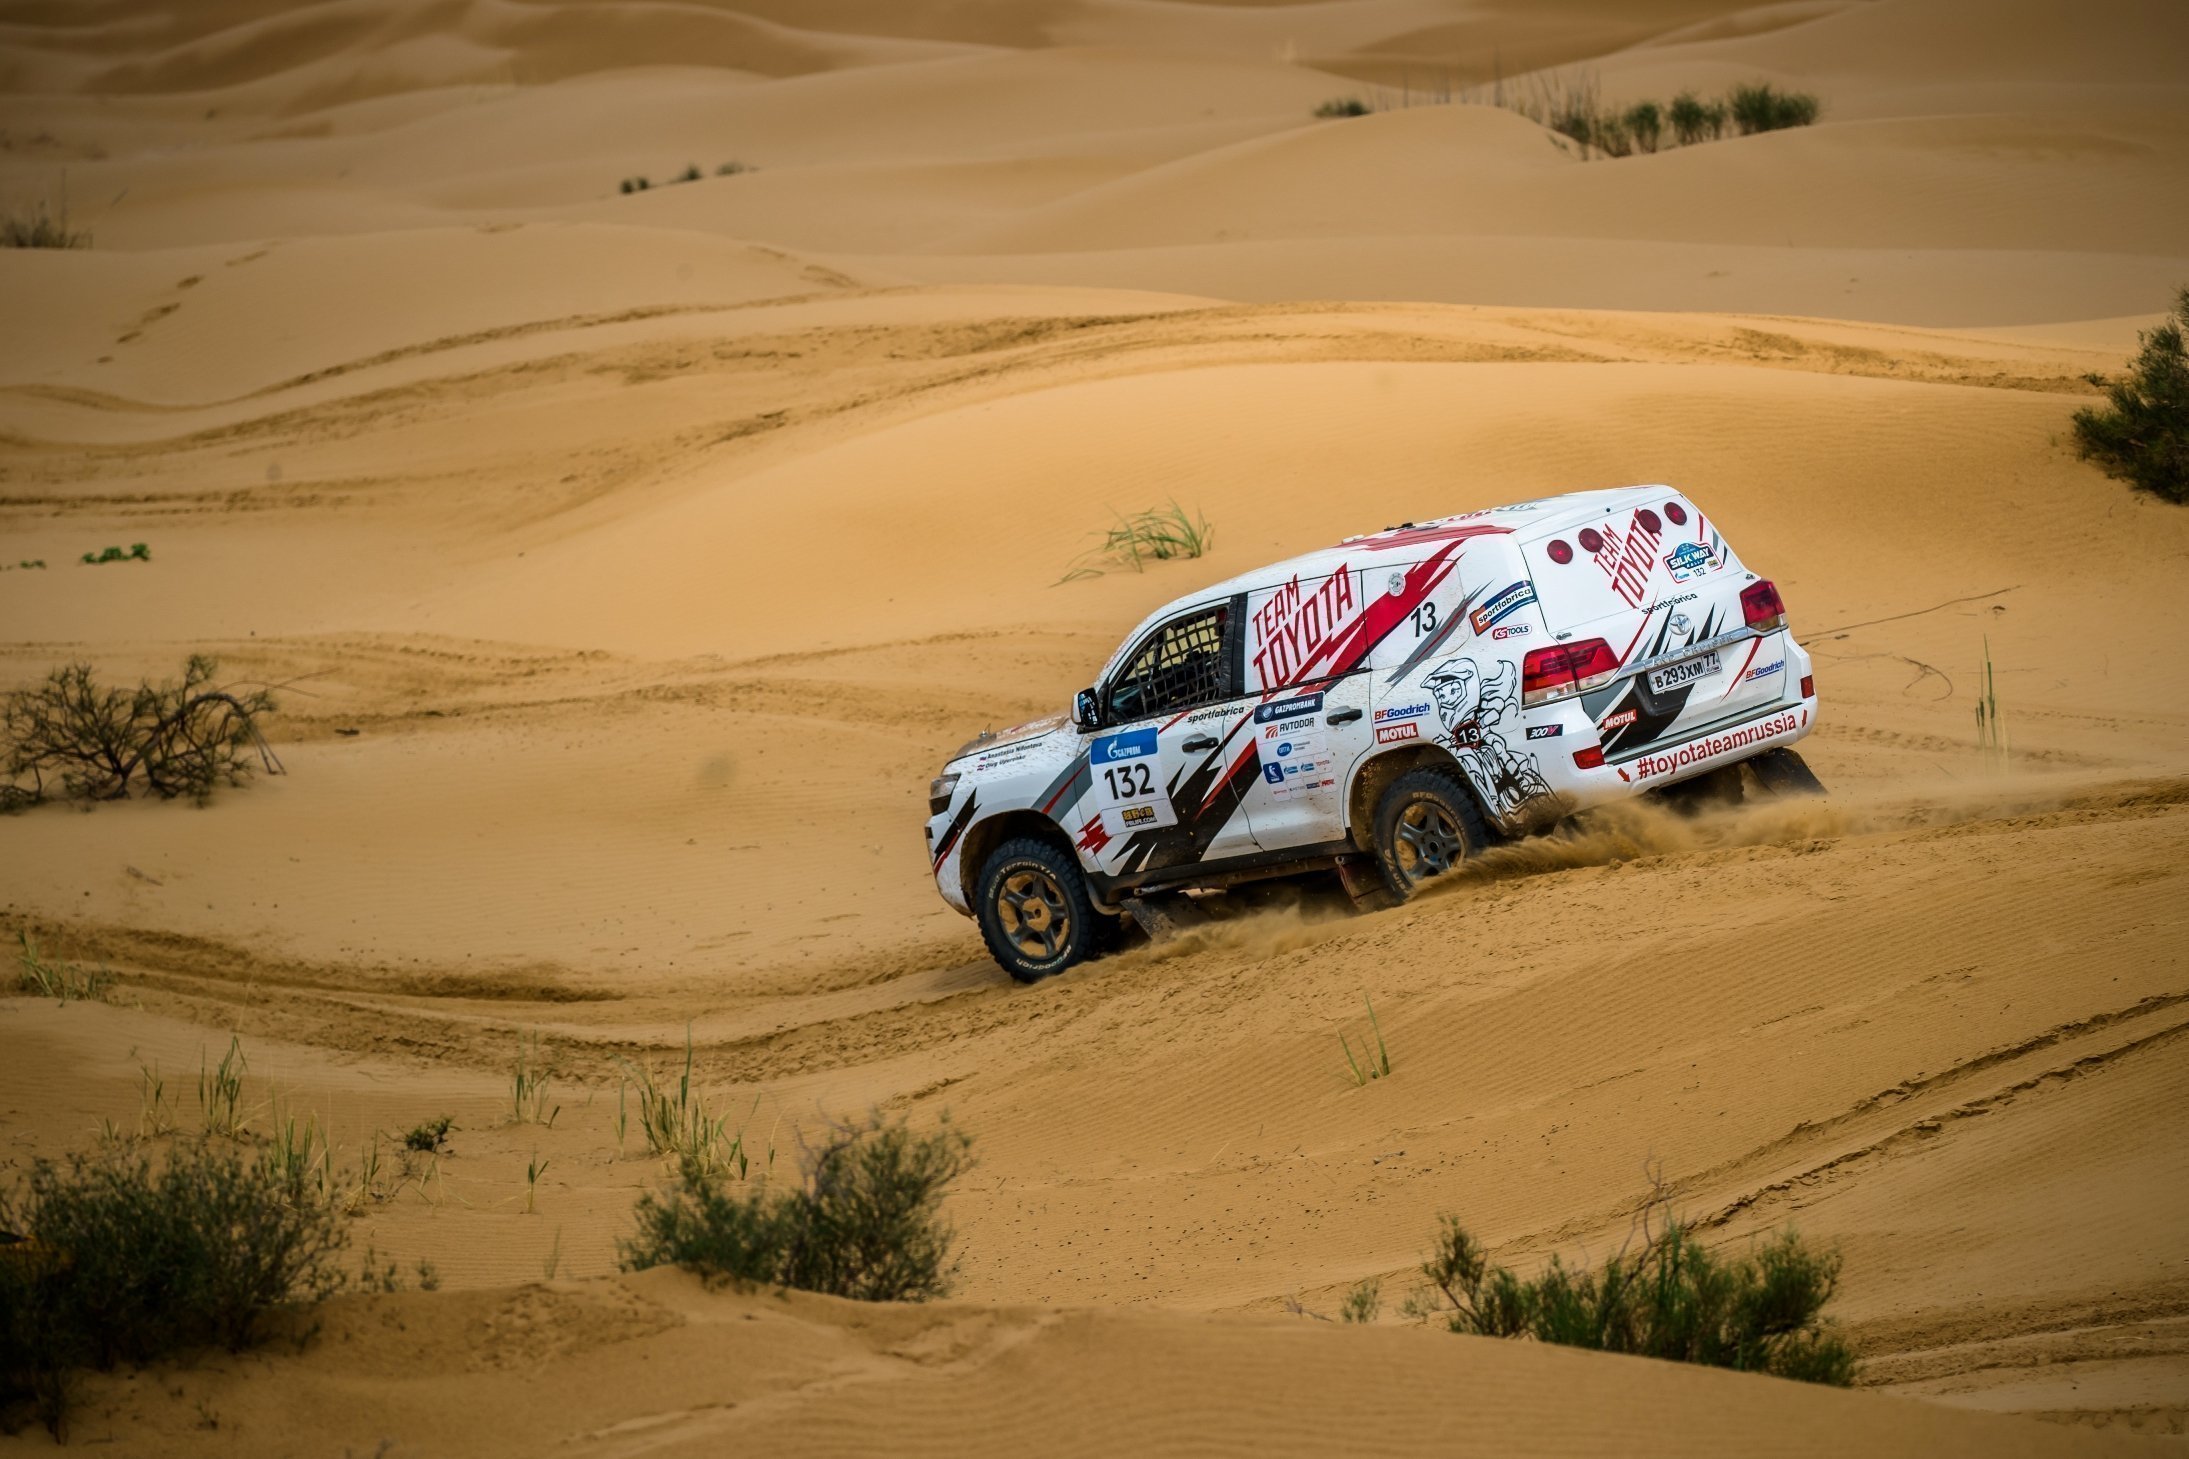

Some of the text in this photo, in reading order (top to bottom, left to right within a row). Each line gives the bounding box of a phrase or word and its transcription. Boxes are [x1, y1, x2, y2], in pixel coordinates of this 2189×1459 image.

[1594, 524, 1622, 577] TEAM
[1669, 554, 1691, 568] SILK
[1691, 548, 1709, 560] WAY
[1693, 567, 1706, 577] 132
[1253, 573, 1300, 647] TEAM
[1478, 588, 1531, 624] sportfabrica
[1410, 602, 1436, 637] 13
[1253, 562, 1353, 703] TOYOTA
[1507, 625, 1529, 635] TOOLS
[1745, 659, 1785, 679] BFGoodrich
[1187, 706, 1245, 725] sportfabrica
[1274, 698, 1316, 715] GAZPROMBANK
[1374, 703, 1431, 721] BFGoodrich
[1279, 717, 1315, 732] AVTODOR
[1604, 713, 1636, 728] MOTUL
[1379, 725, 1417, 743] MOTUL
[1459, 728, 1480, 744] 13
[1116, 745, 1141, 758] GAZPROM
[1637, 712, 1797, 780] #toyotateamrussia
[1104, 763, 1155, 800] 132
